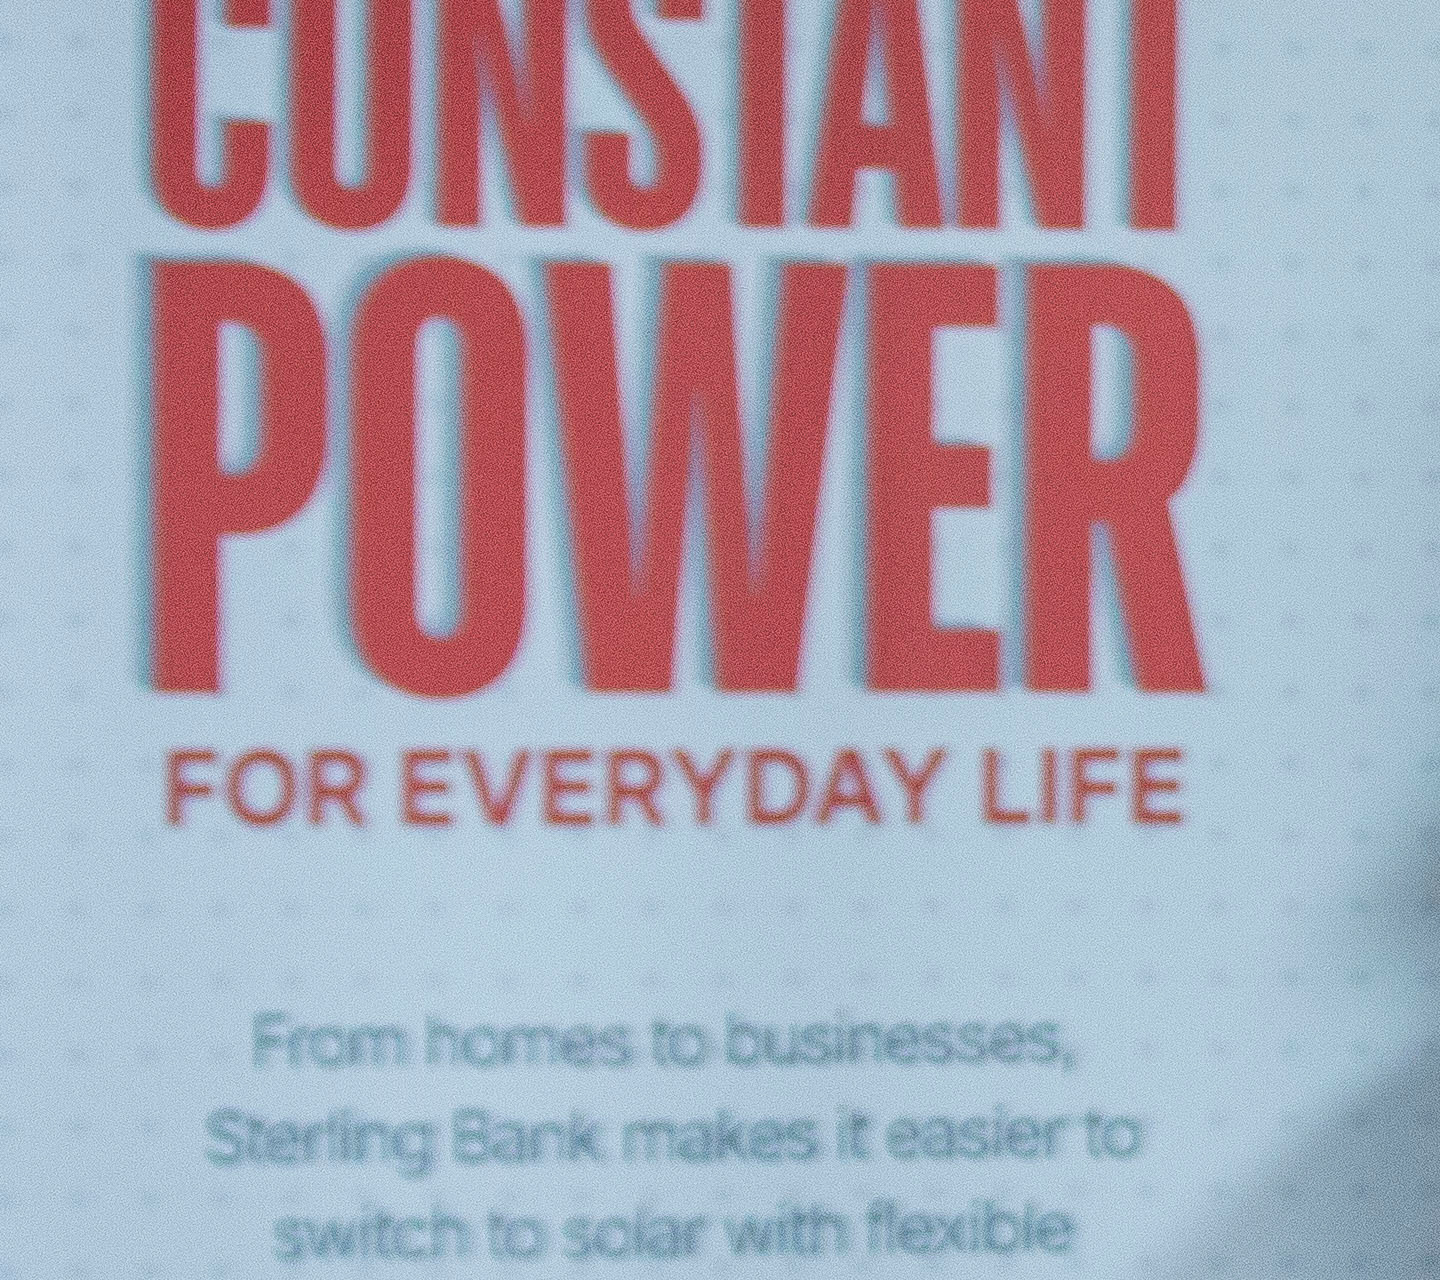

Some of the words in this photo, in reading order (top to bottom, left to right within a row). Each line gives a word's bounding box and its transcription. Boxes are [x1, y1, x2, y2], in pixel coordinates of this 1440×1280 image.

[146, 254, 1207, 698] POWER
[166, 746, 369, 827] FOR
[399, 746, 949, 827] EVERYDAY
[980, 746, 1187, 827] LIFE
[252, 1008, 408, 1070] From
[425, 1011, 637, 1070] homes
[652, 1016, 708, 1069] to
[724, 1009, 1078, 1075] businesses,
[205, 1106, 435, 1180] Sterling
[453, 1106, 603, 1167] Bank
[621, 1105, 819, 1165] makes
[835, 1103, 872, 1161] it
[885, 1103, 1071, 1161] easier
[1084, 1106, 1144, 1161] to
[273, 1202, 471, 1262] switch
[487, 1209, 544, 1261] to
[563, 1200, 706, 1261] solar
[724, 1198, 852, 1258] with
[866, 1195, 1077, 1257] flexible
